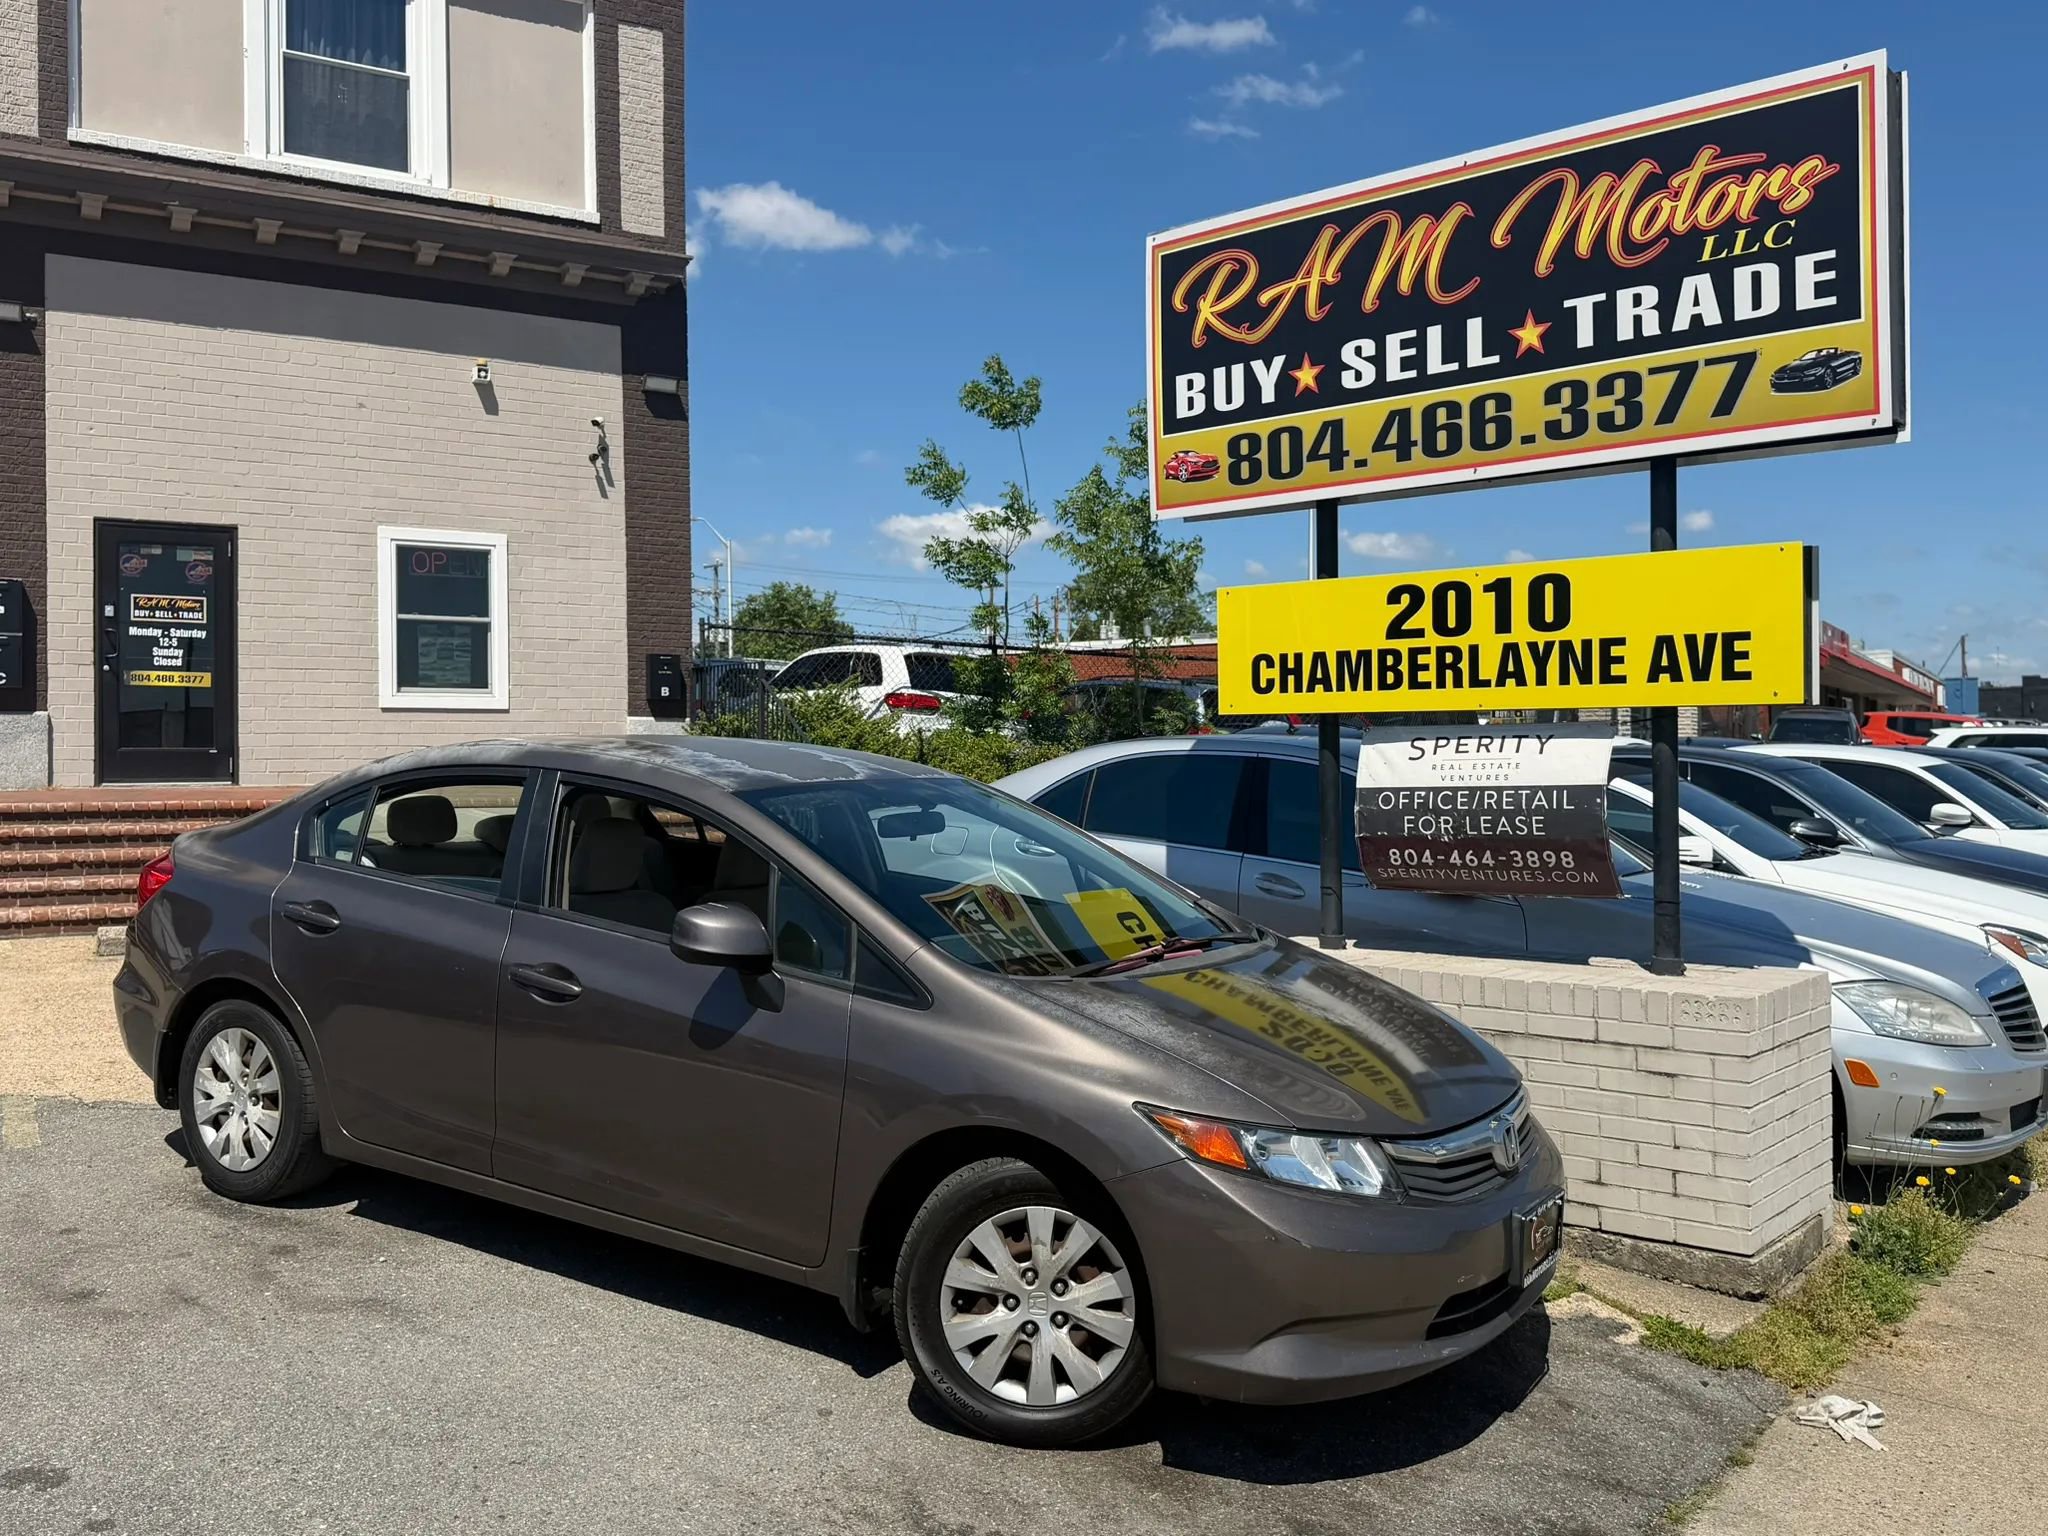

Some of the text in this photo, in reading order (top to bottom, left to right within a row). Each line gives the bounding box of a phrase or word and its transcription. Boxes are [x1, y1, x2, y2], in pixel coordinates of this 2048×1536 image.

[1171, 144, 1840, 348] RAM Motors
[1697, 219, 1797, 263] LLC
[1175, 249, 1838, 419] BUY SELL TRADE
[1227, 351, 1759, 486] 804.466.3377
[136, 597, 170, 608] RAM
[1385, 573, 1571, 640] 2010
[129, 626, 162, 637] Monday
[170, 628, 207, 639] Saturday
[159, 638, 178, 647] 12-5
[152, 647, 184, 657] Sunday
[153, 657, 182, 666] Closed
[1251, 631, 1753, 695] CHAMBERLAYNE AVE
[661, 687, 670, 696] B
[1408, 734, 1555, 761] SPERITY
[1432, 762, 1521, 771] REAL ESTATE
[1440, 774, 1510, 782] VENTURES
[1378, 789, 1576, 810] OFFICE/RETAIL
[1404, 816, 1546, 836] FOR LEASE
[1389, 848, 1575, 868] 804-464-3898
[1378, 867, 1599, 884] SPERITYVENTURES.COM
